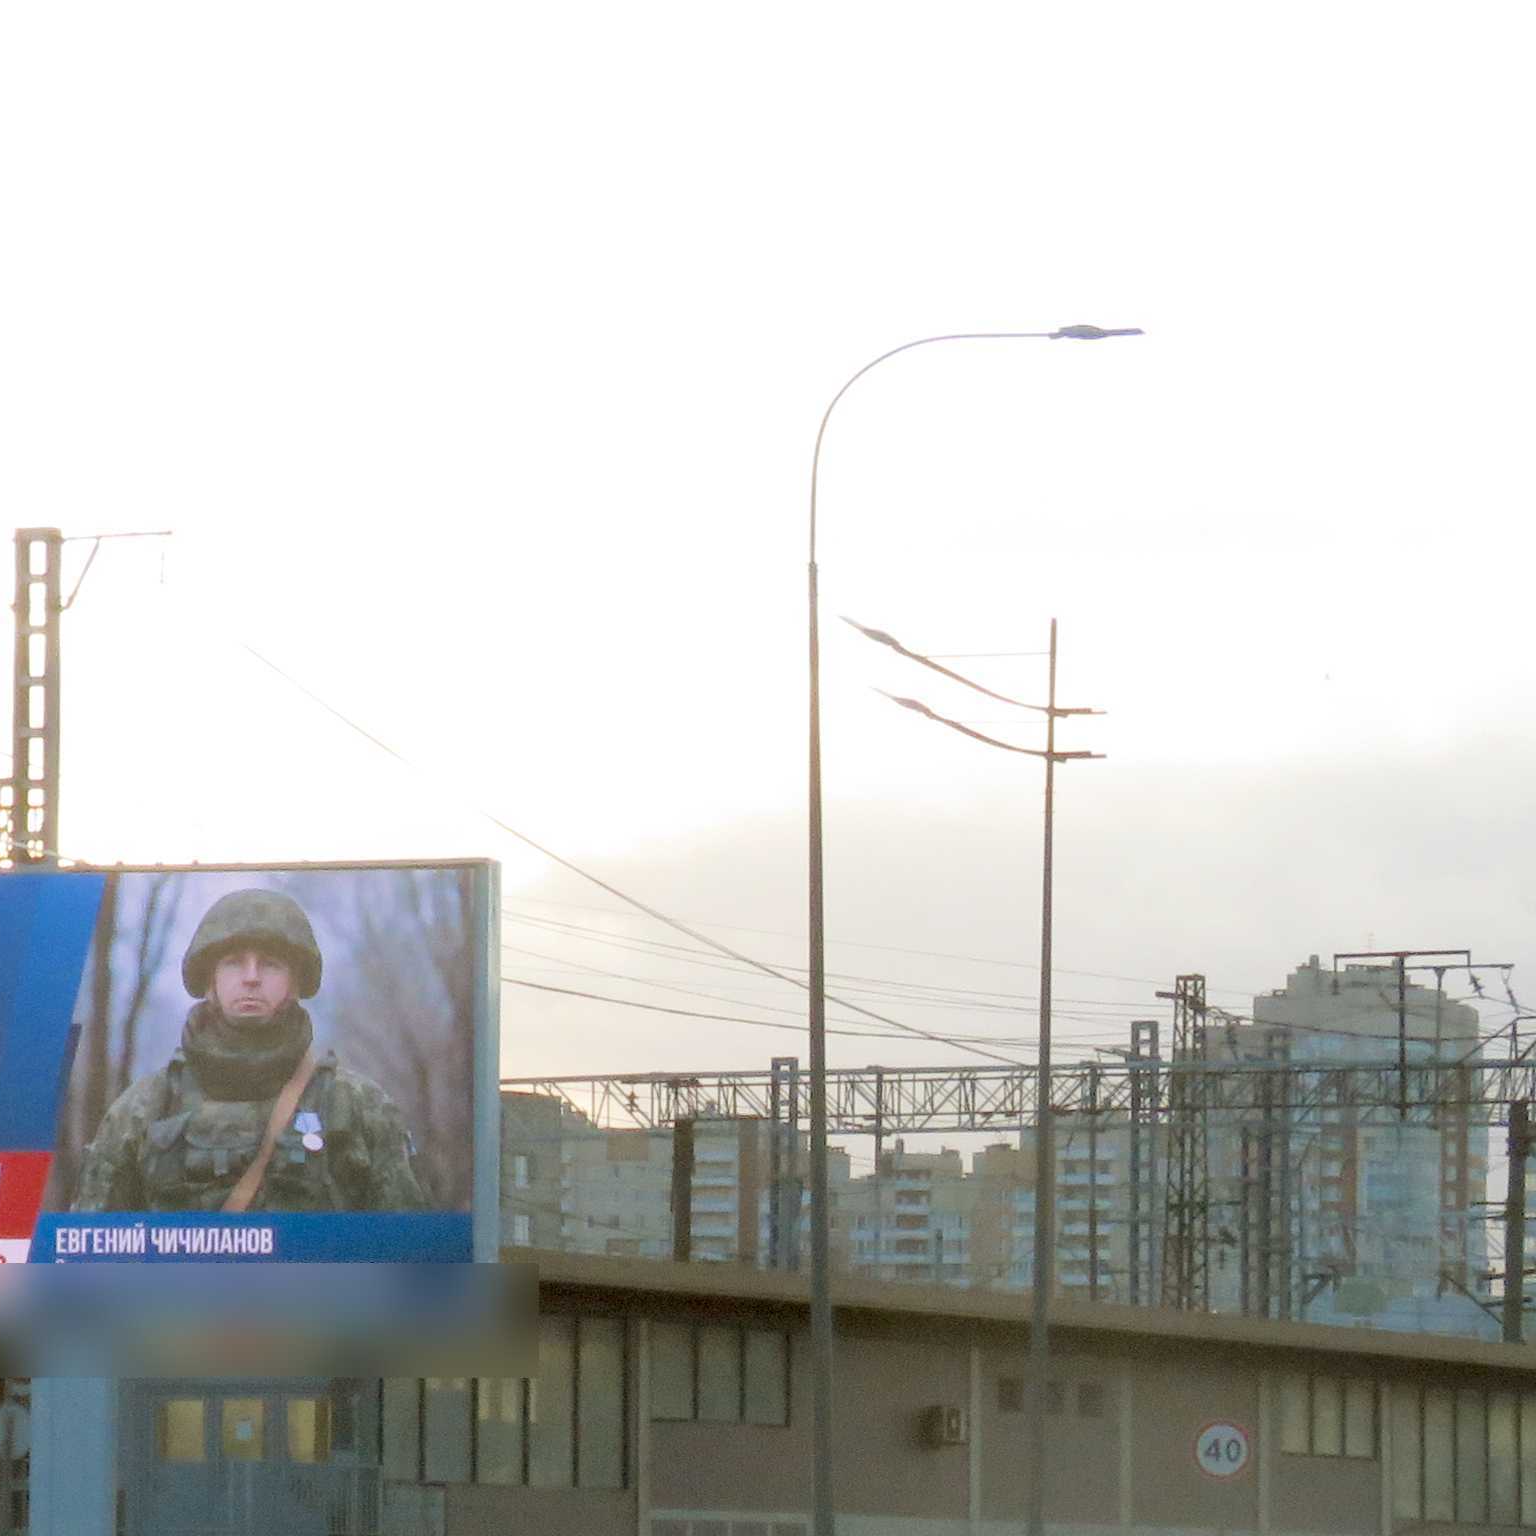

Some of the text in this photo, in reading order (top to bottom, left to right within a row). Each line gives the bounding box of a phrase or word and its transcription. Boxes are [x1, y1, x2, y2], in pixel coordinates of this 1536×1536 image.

[56, 1222, 273, 1254] ЕВГЕНИЙ ЧИЧИЛАНОВ
[1204, 1438, 1241, 1462] 40
